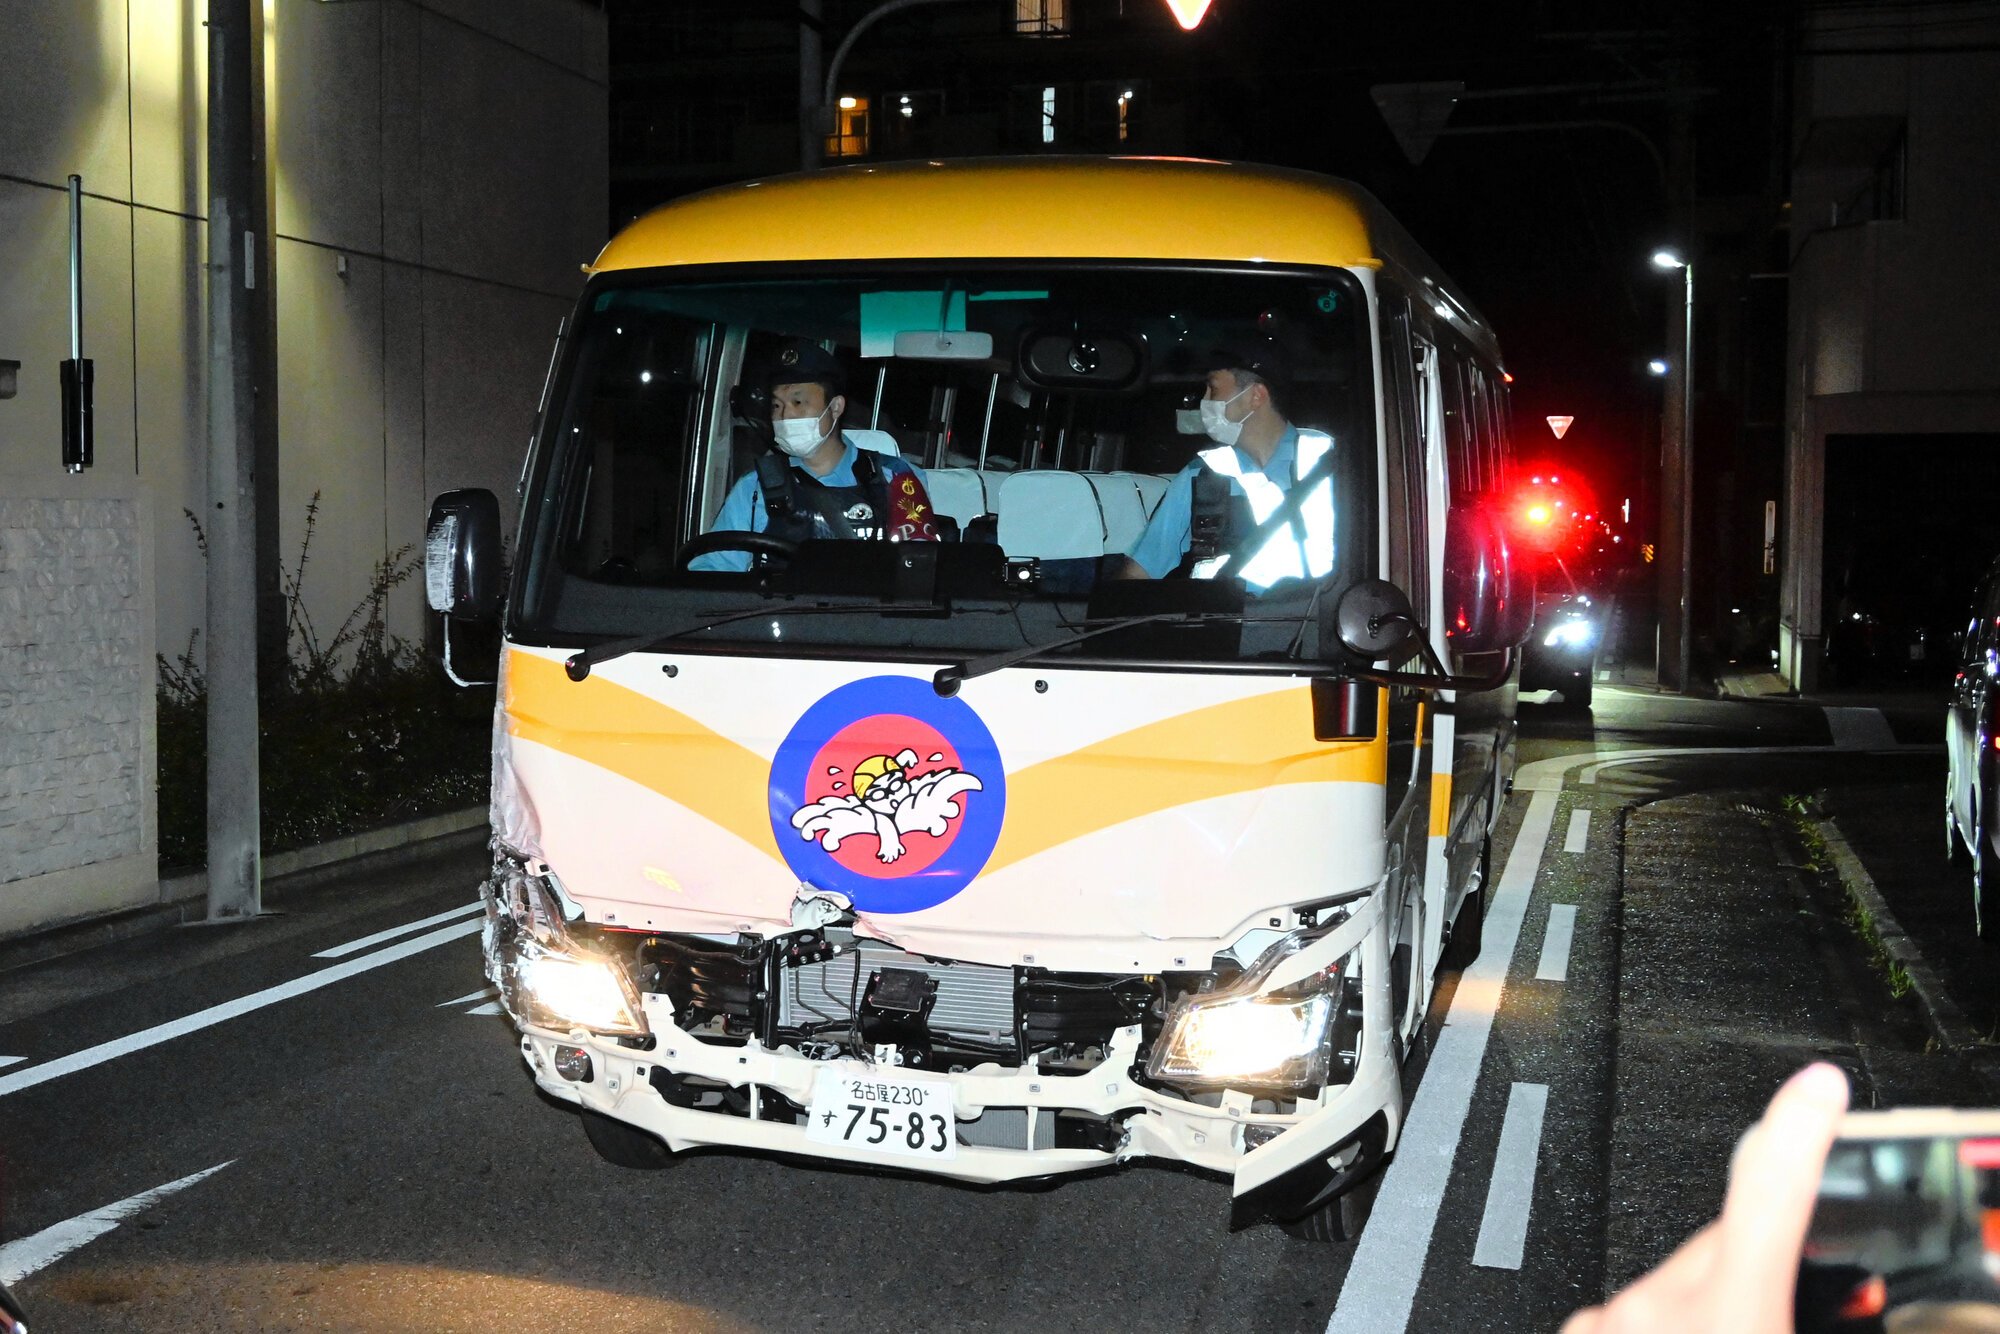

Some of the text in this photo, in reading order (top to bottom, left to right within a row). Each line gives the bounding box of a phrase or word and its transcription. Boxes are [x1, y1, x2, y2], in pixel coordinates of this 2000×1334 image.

[851, 1080, 923, 1106] 名古屋230
[821, 1104, 947, 1152] す 75-83
